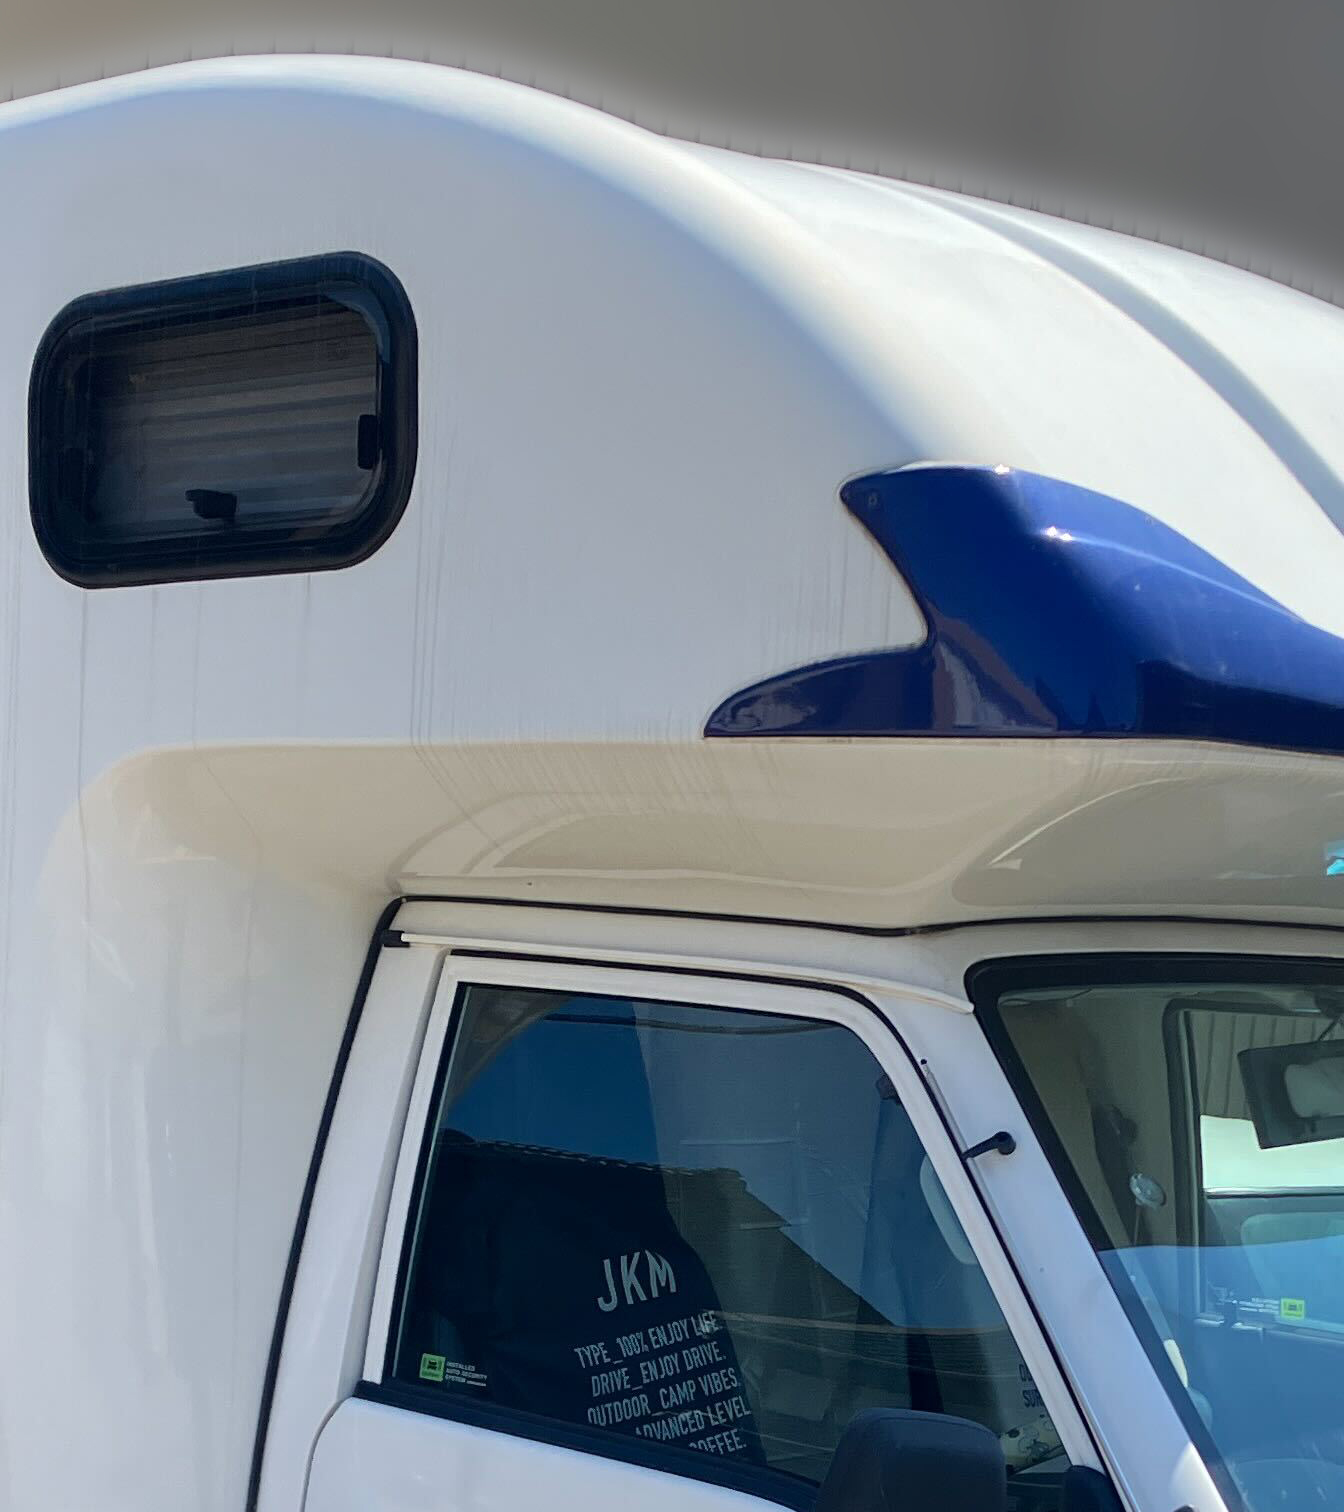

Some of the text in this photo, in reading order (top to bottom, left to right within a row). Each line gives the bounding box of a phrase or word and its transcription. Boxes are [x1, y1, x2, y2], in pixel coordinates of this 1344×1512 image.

[597, 1249, 676, 1312] JKM
[648, 1319, 690, 1348] ENJOY
[683, 1341, 726, 1371] DRIVE.
